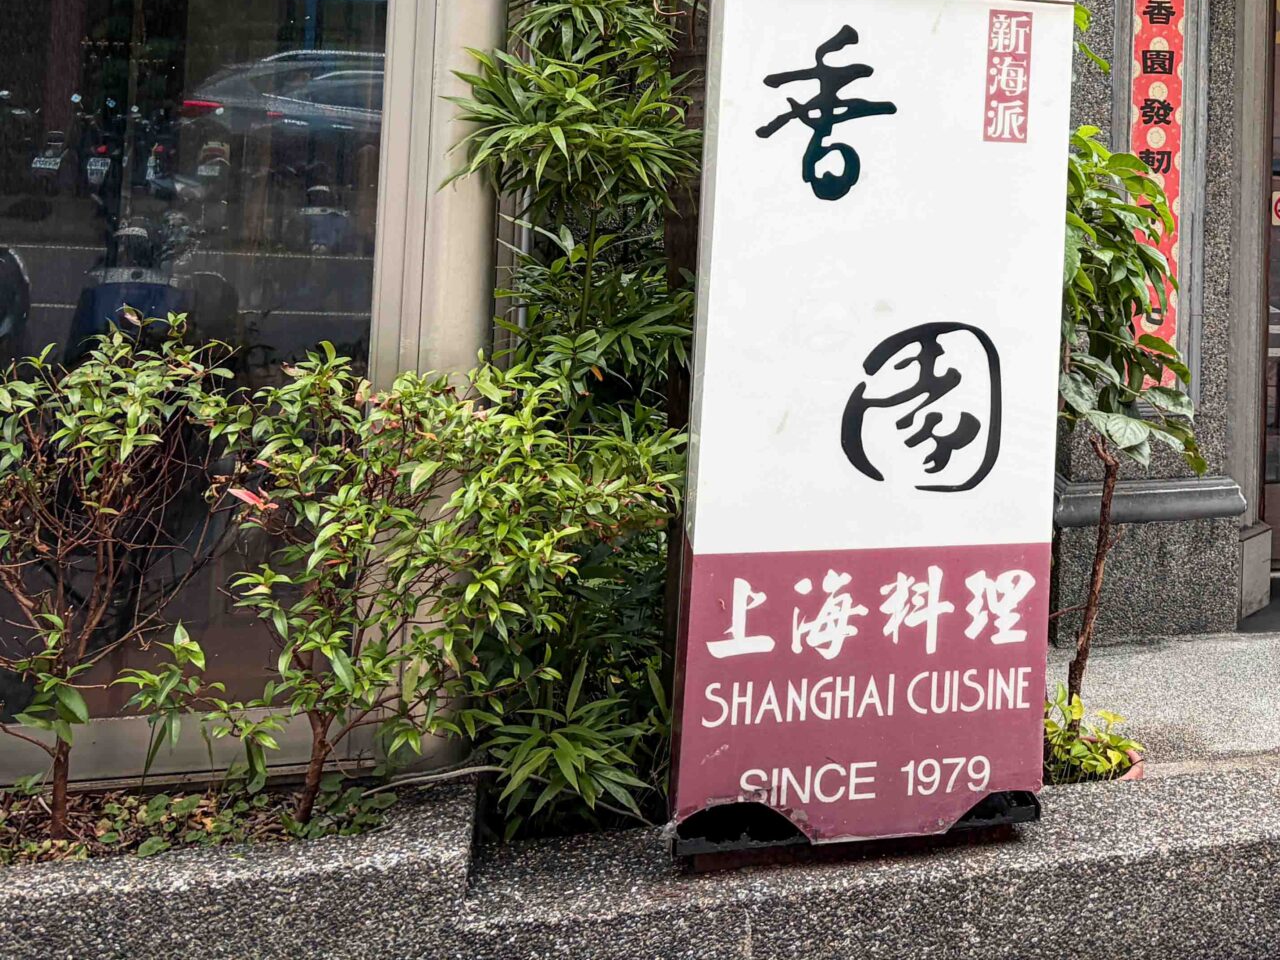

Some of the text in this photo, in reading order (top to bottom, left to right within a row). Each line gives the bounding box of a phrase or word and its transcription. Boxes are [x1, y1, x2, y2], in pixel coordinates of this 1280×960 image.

[988, 13, 1030, 141] 新海派
[705, 563, 1038, 660] 上海料理
[701, 666, 1032, 728] SHANGHAI CUISINE
[738, 755, 993, 807] SINCE 1979
